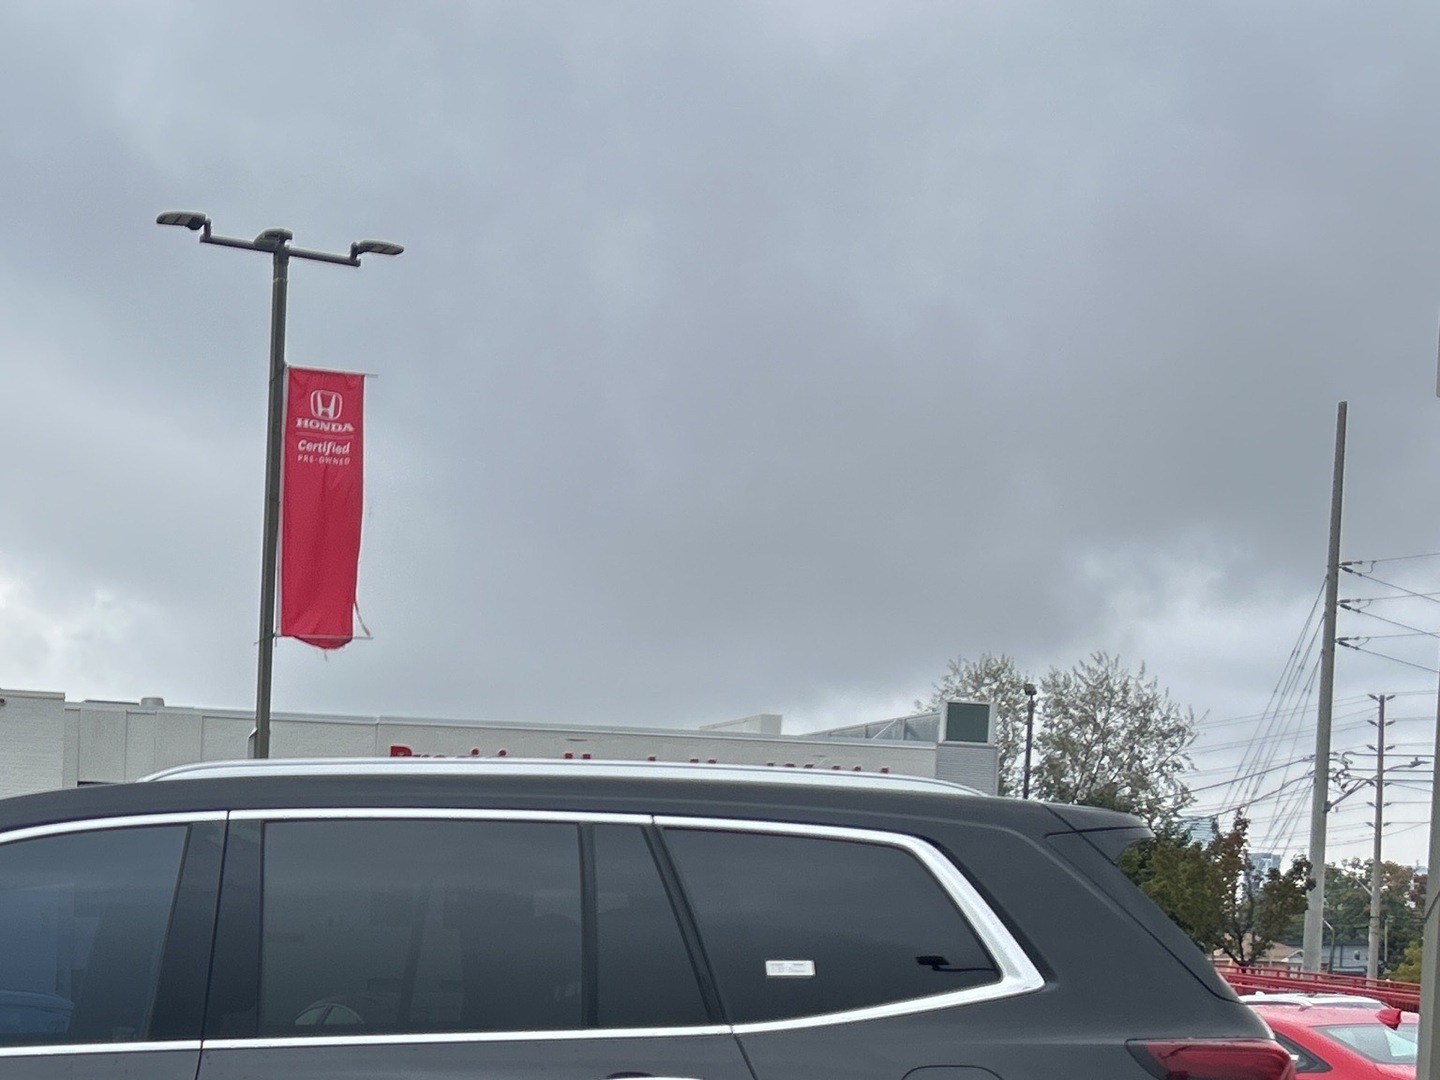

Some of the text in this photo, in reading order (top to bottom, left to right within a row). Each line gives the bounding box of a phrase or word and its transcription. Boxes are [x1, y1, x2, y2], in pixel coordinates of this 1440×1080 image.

[295, 417, 355, 432] HONDA
[297, 439, 351, 456] Certified
[297, 454, 351, 466] PRE-OWNED
